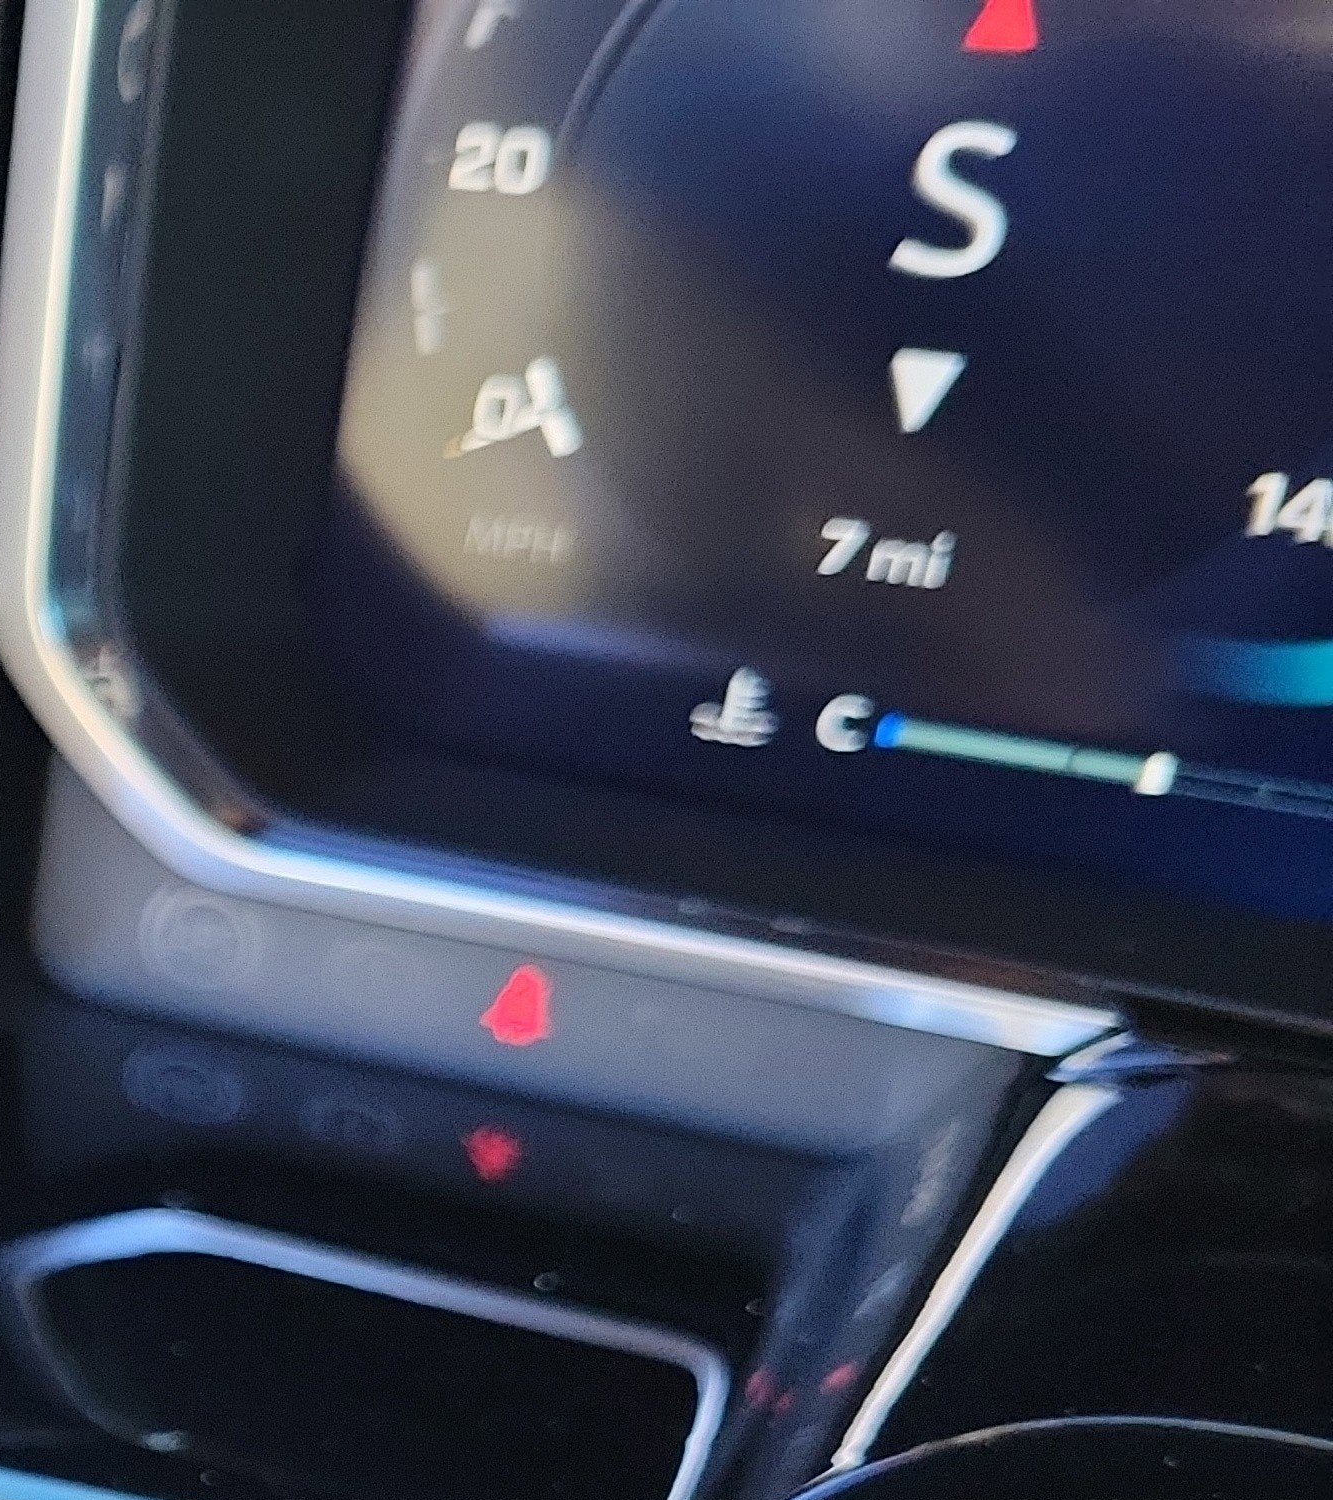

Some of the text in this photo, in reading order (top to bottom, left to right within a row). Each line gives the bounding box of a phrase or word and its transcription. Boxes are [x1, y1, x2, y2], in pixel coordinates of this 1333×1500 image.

[447, 121, 554, 195] 20
[888, 120, 1018, 279] S
[1242, 470, 1333, 550] 14
[817, 516, 958, 590] 7 mi
[814, 694, 876, 753] C
